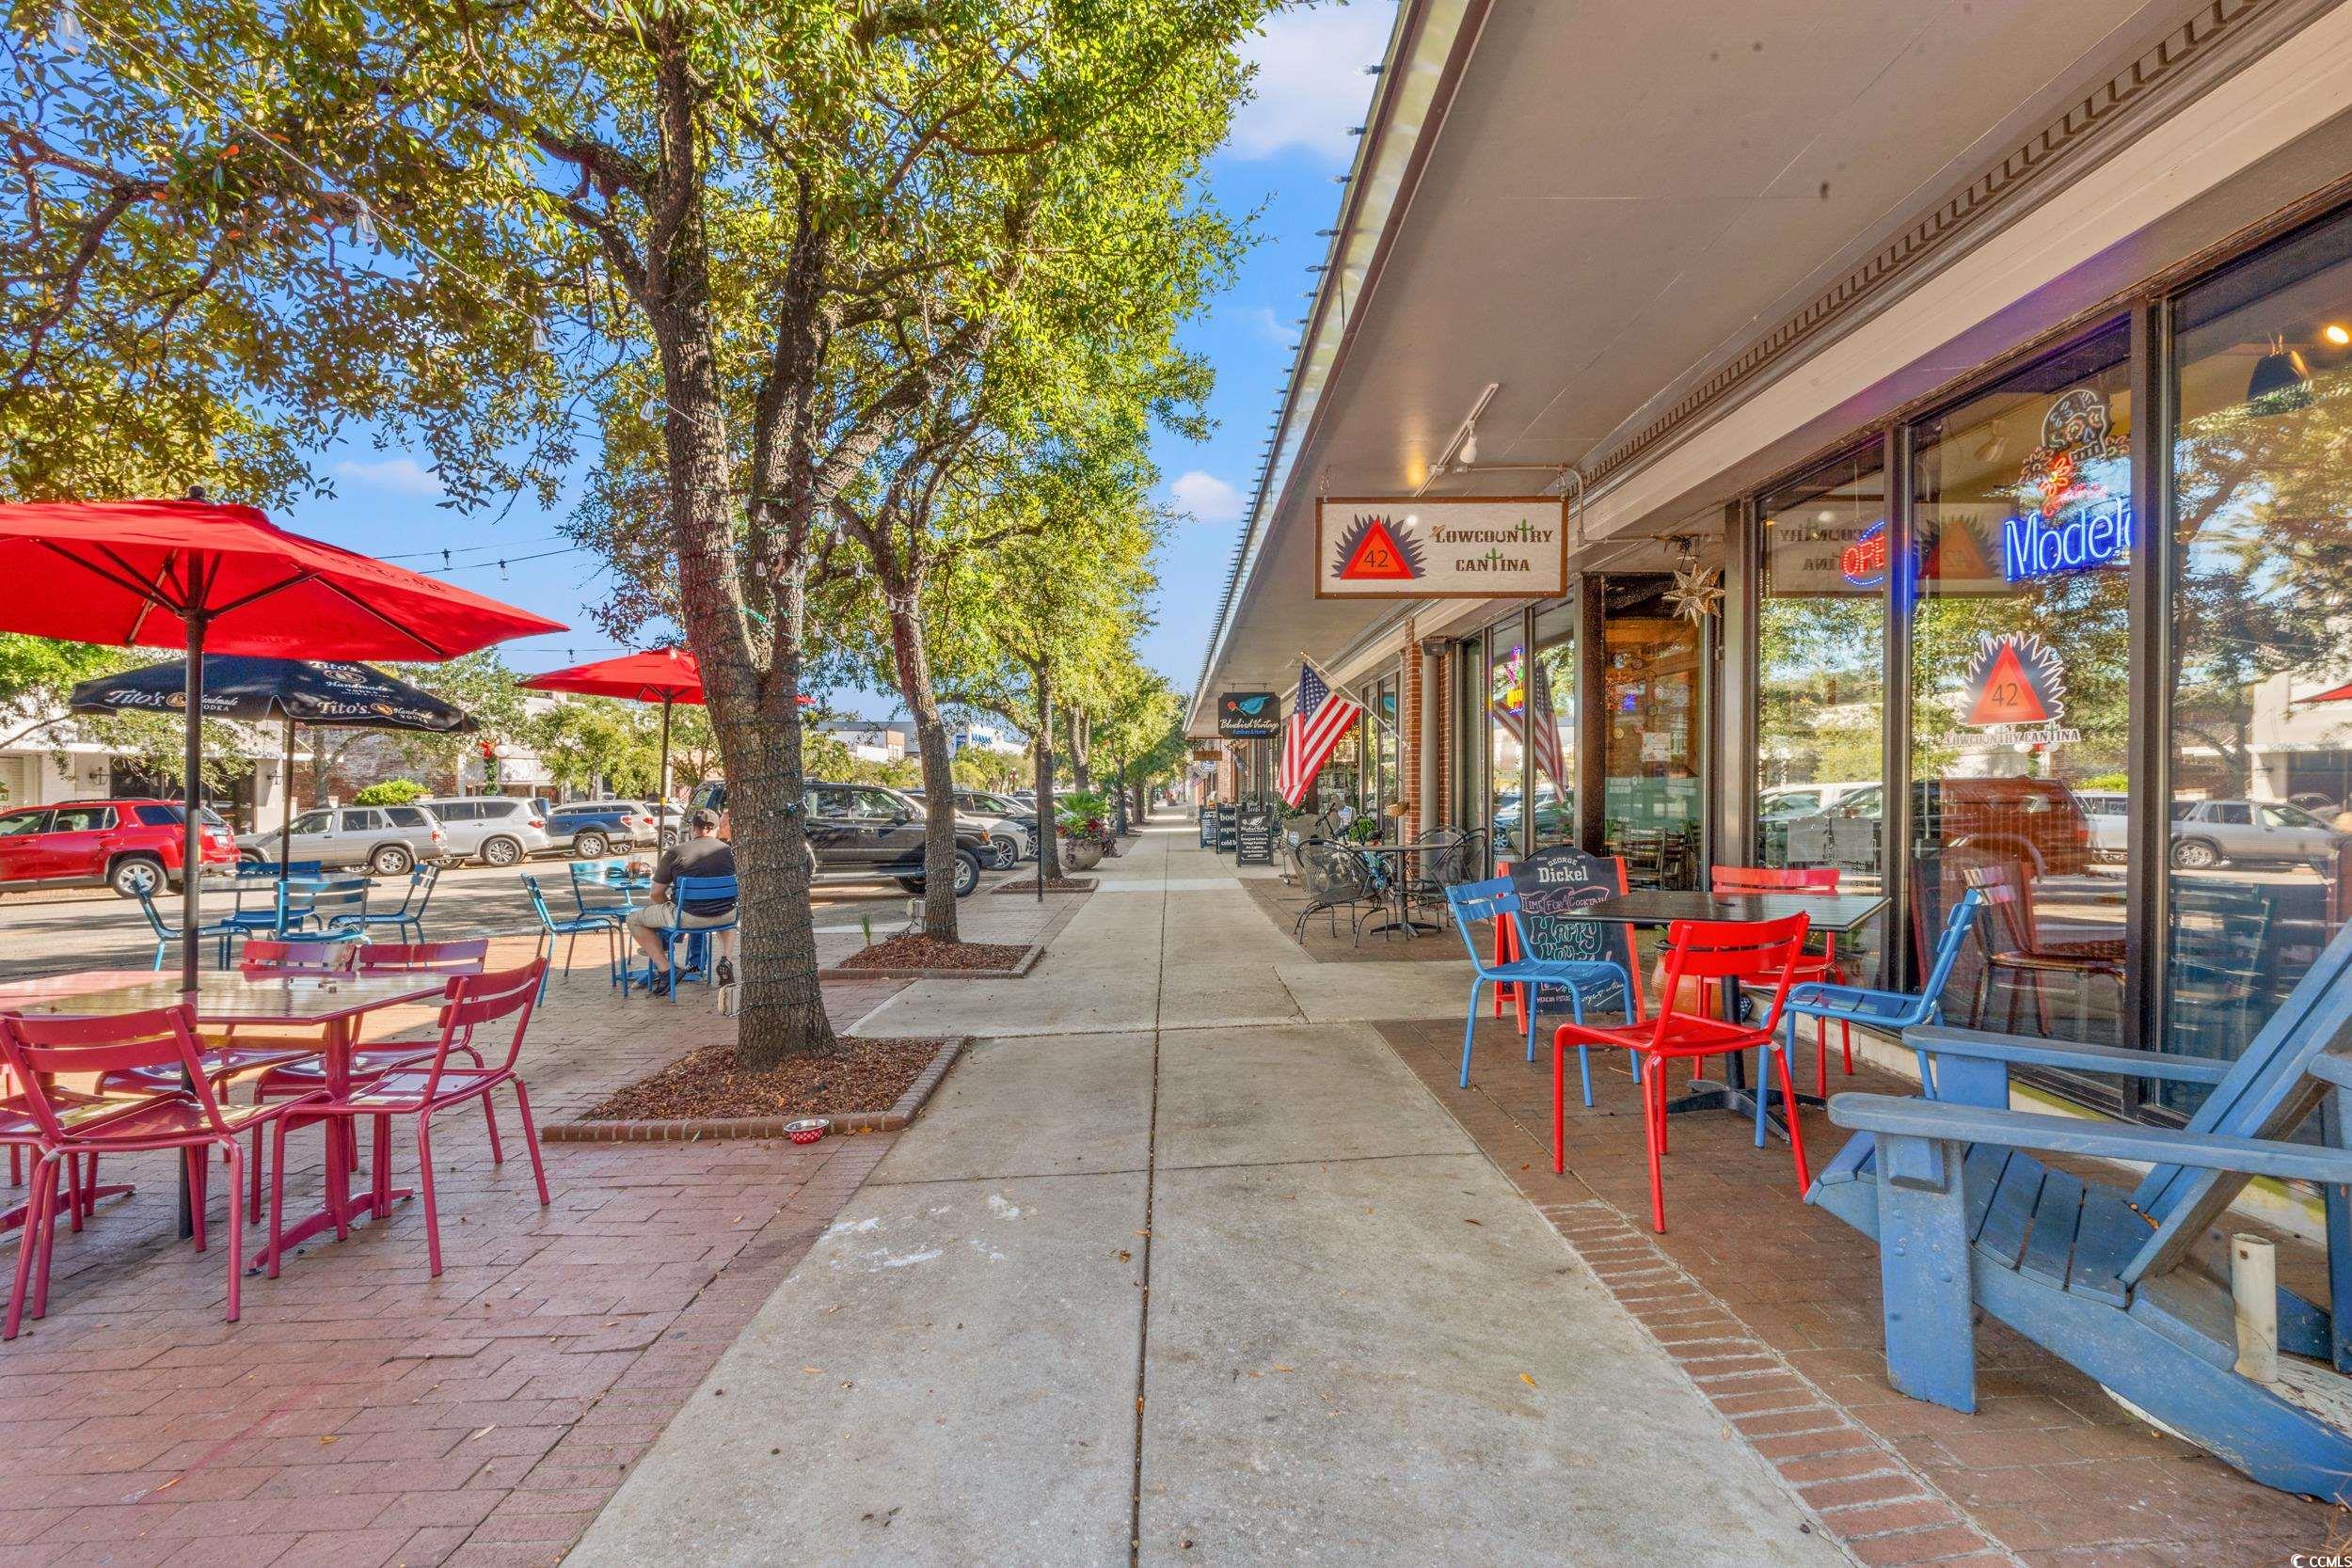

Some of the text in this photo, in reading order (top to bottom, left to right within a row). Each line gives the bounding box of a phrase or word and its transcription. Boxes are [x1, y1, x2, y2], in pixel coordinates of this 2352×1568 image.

[1433, 519, 1553, 544] LOWCOUNTRY
[1364, 549, 1390, 568] 42
[1455, 547, 1531, 572] CANTINA
[200, 693, 239, 706] andmade
[1991, 683, 2019, 706] 42
[200, 704, 230, 712] ODKA
[2023, 721, 2079, 744] CANTINA
[1548, 857, 1578, 867] GEORGE
[1537, 865, 1589, 883] Dickel
